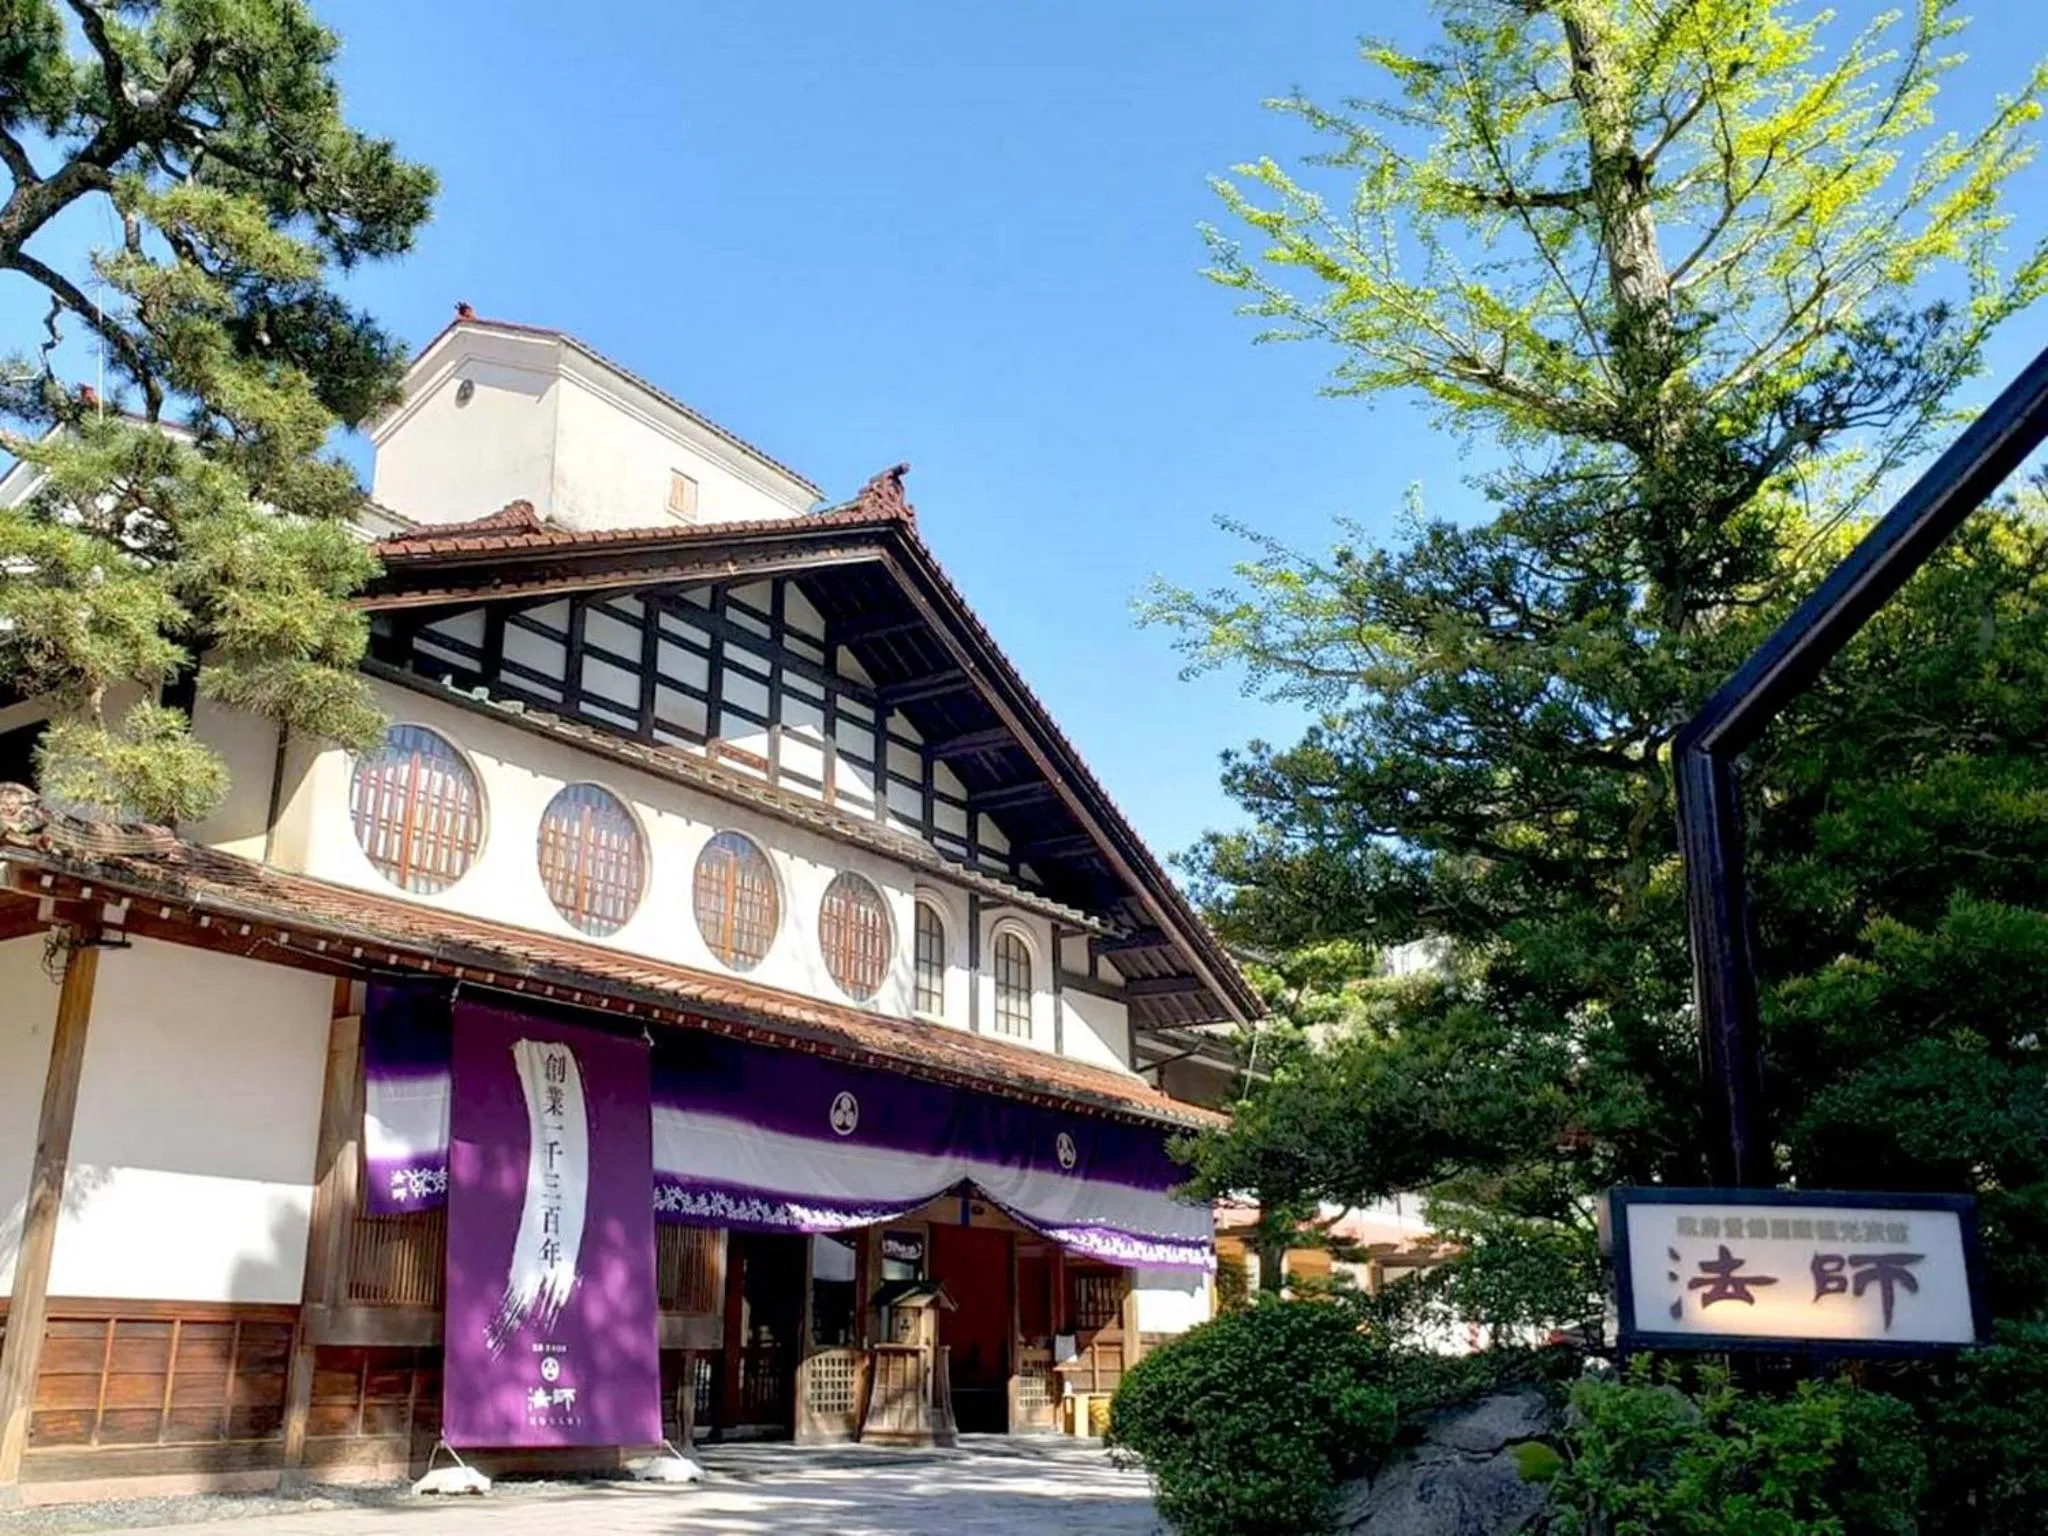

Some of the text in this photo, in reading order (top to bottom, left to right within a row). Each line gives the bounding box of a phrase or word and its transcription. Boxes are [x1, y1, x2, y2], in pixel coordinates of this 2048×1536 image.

[540, 1053, 567, 1269] 創業一千三百年
[1668, 1244, 1926, 1332] 法師
